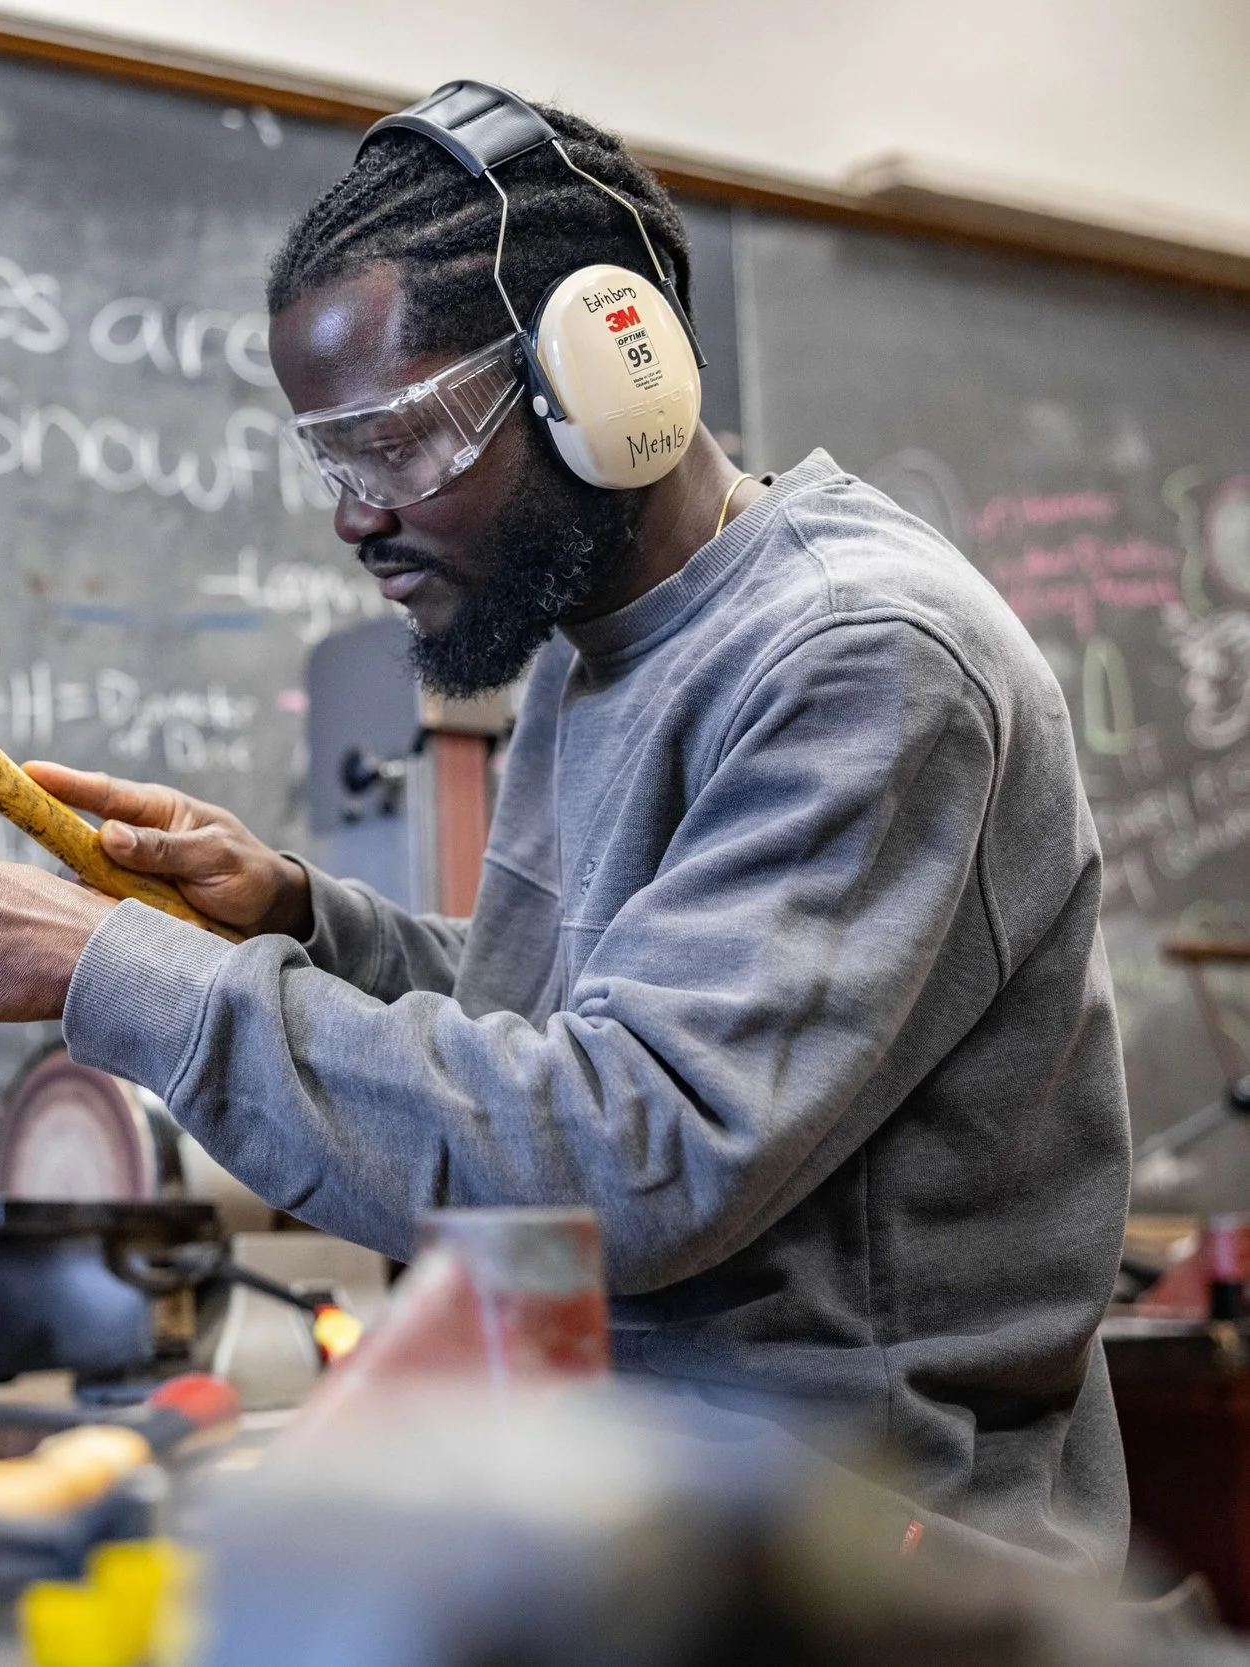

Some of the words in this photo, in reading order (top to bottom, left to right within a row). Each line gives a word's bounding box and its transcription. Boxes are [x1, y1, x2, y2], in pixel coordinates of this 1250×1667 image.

[605, 305, 641, 332] 3M
[89, 296, 280, 389] are
[618, 330, 647, 345] OPTIME
[627, 343, 653, 367] 95
[626, 424, 685, 468] Metals
